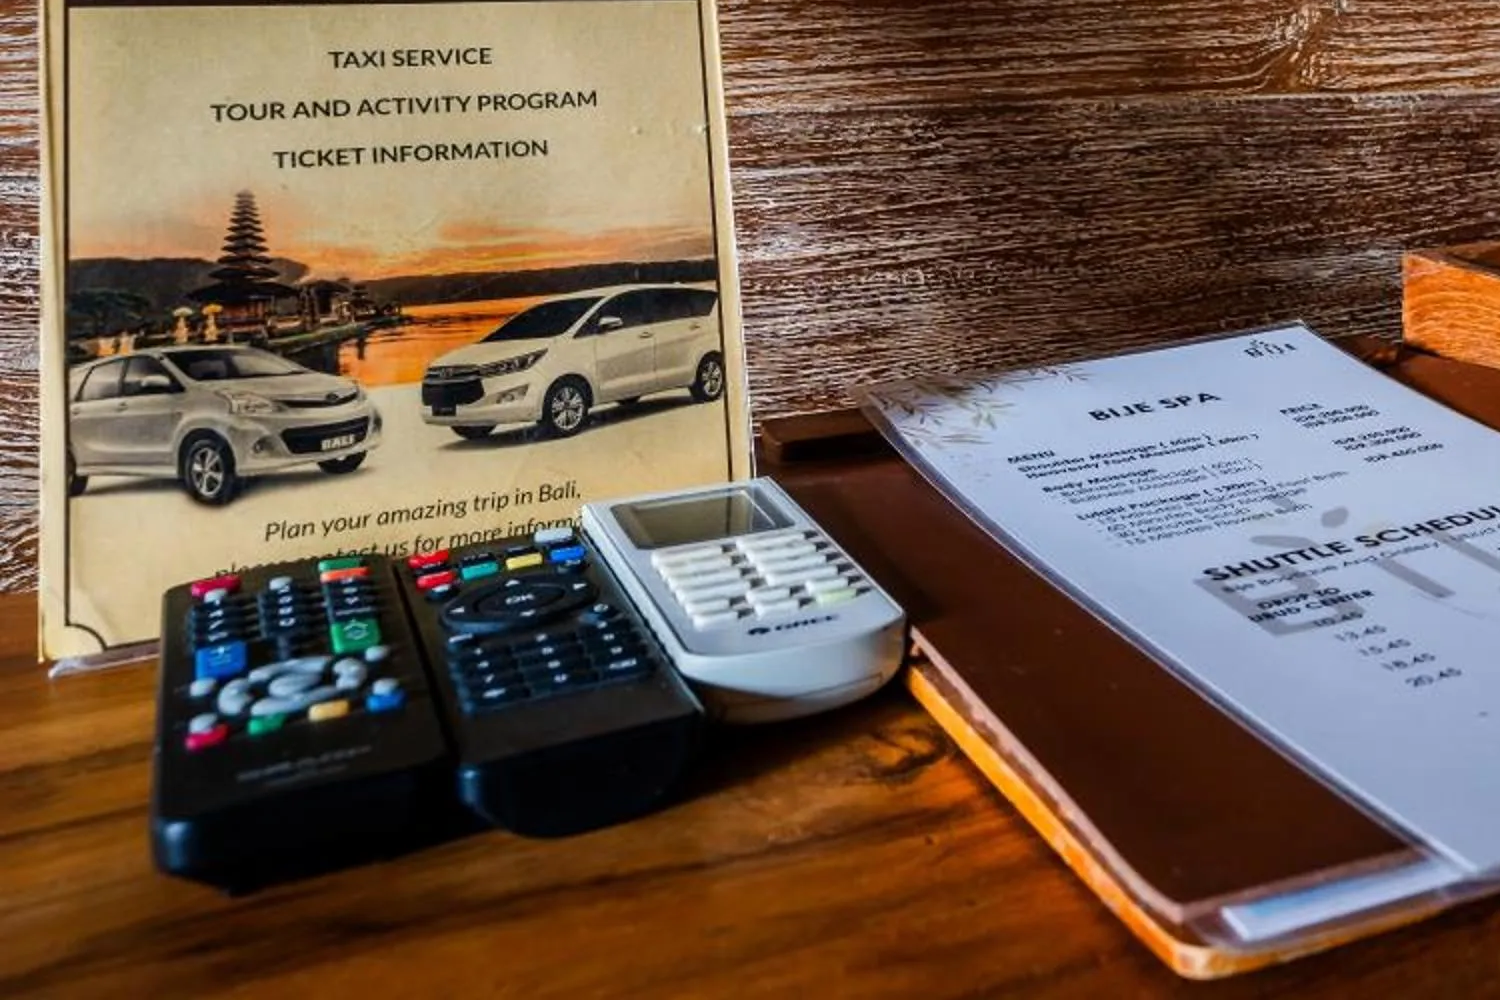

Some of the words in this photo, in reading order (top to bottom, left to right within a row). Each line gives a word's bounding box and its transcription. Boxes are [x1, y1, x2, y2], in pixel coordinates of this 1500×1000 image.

[328, 51, 386, 69] TAXI
[392, 48, 492, 67] SERVICE
[210, 102, 285, 123] TOUR
[292, 100, 350, 120] AND
[357, 95, 472, 117] ACTIVITY
[477, 90, 598, 112] PROGRAM
[273, 147, 366, 169] TICKET
[372, 139, 549, 164] INFORMATION
[1088, 401, 1154, 421] BIJE
[1158, 392, 1221, 409] SPA
[265, 519, 315, 541] Plan
[322, 513, 371, 537] your
[377, 498, 467, 526] amazing
[473, 491, 509, 512] trip
[515, 487, 533, 505] in
[385, 540, 408, 558] us
[414, 534, 445, 554] for
[450, 529, 502, 549] more
[1203, 541, 1354, 581] SHUTTLE
